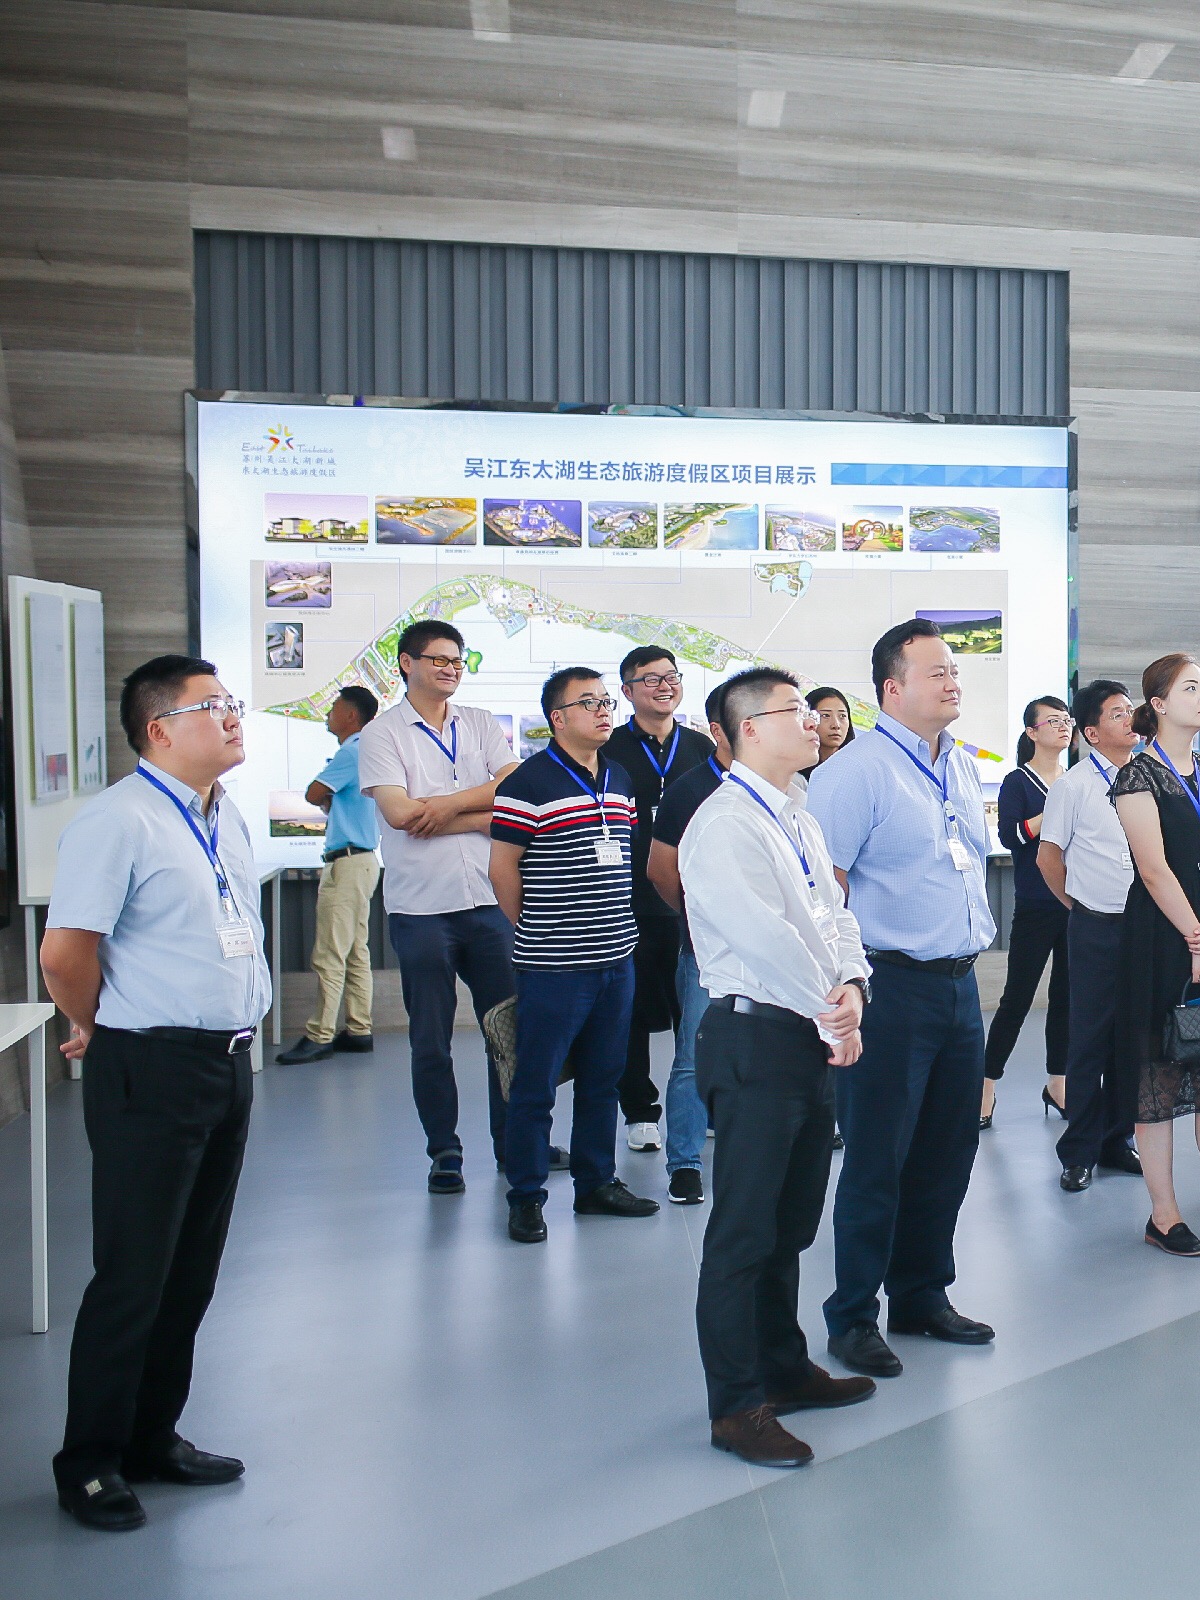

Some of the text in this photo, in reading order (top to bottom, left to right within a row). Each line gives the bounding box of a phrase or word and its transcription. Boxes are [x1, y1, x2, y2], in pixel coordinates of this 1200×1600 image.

[464, 457, 817, 485] 吴江东太湖生态旅游度假区项目展示
